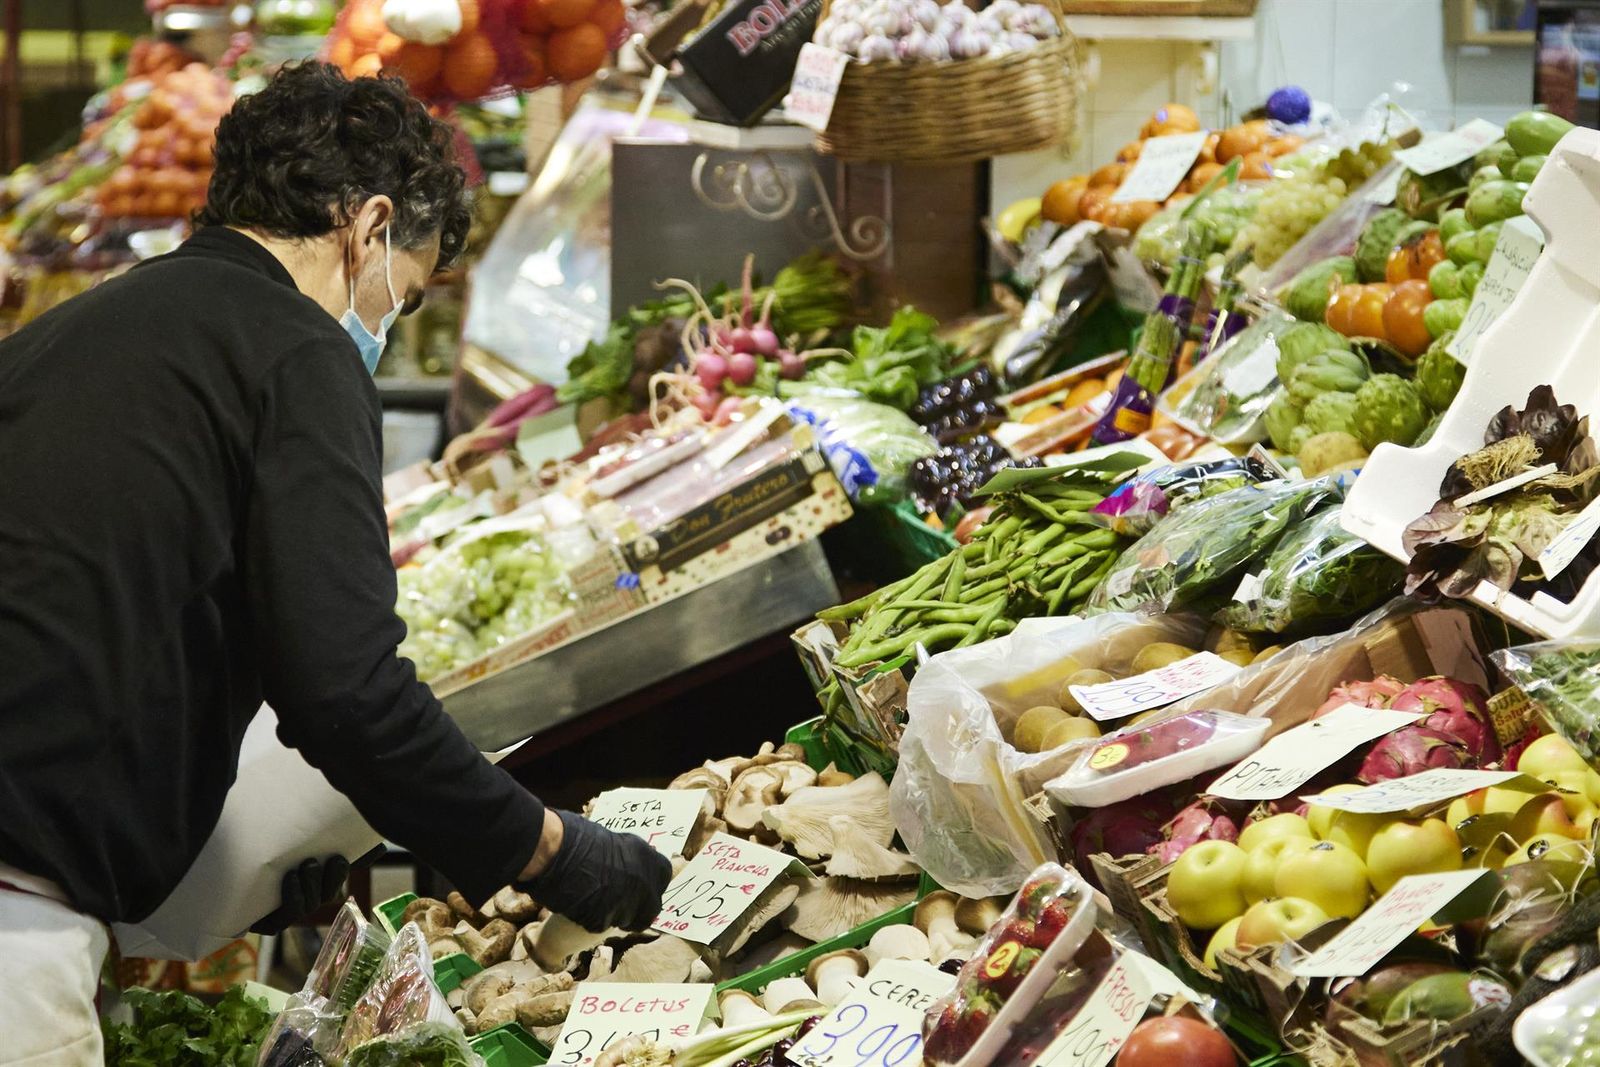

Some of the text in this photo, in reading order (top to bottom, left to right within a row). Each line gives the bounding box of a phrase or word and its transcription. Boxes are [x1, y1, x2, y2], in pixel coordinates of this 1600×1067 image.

[619, 799, 663, 813] SETA
[702, 841, 741, 859] SETA
[711, 857, 770, 877] PLANCHA
[869, 980, 939, 1014] CERE
[1104, 965, 1146, 1022] FRESAS
[579, 996, 690, 1015] BOLETUS
